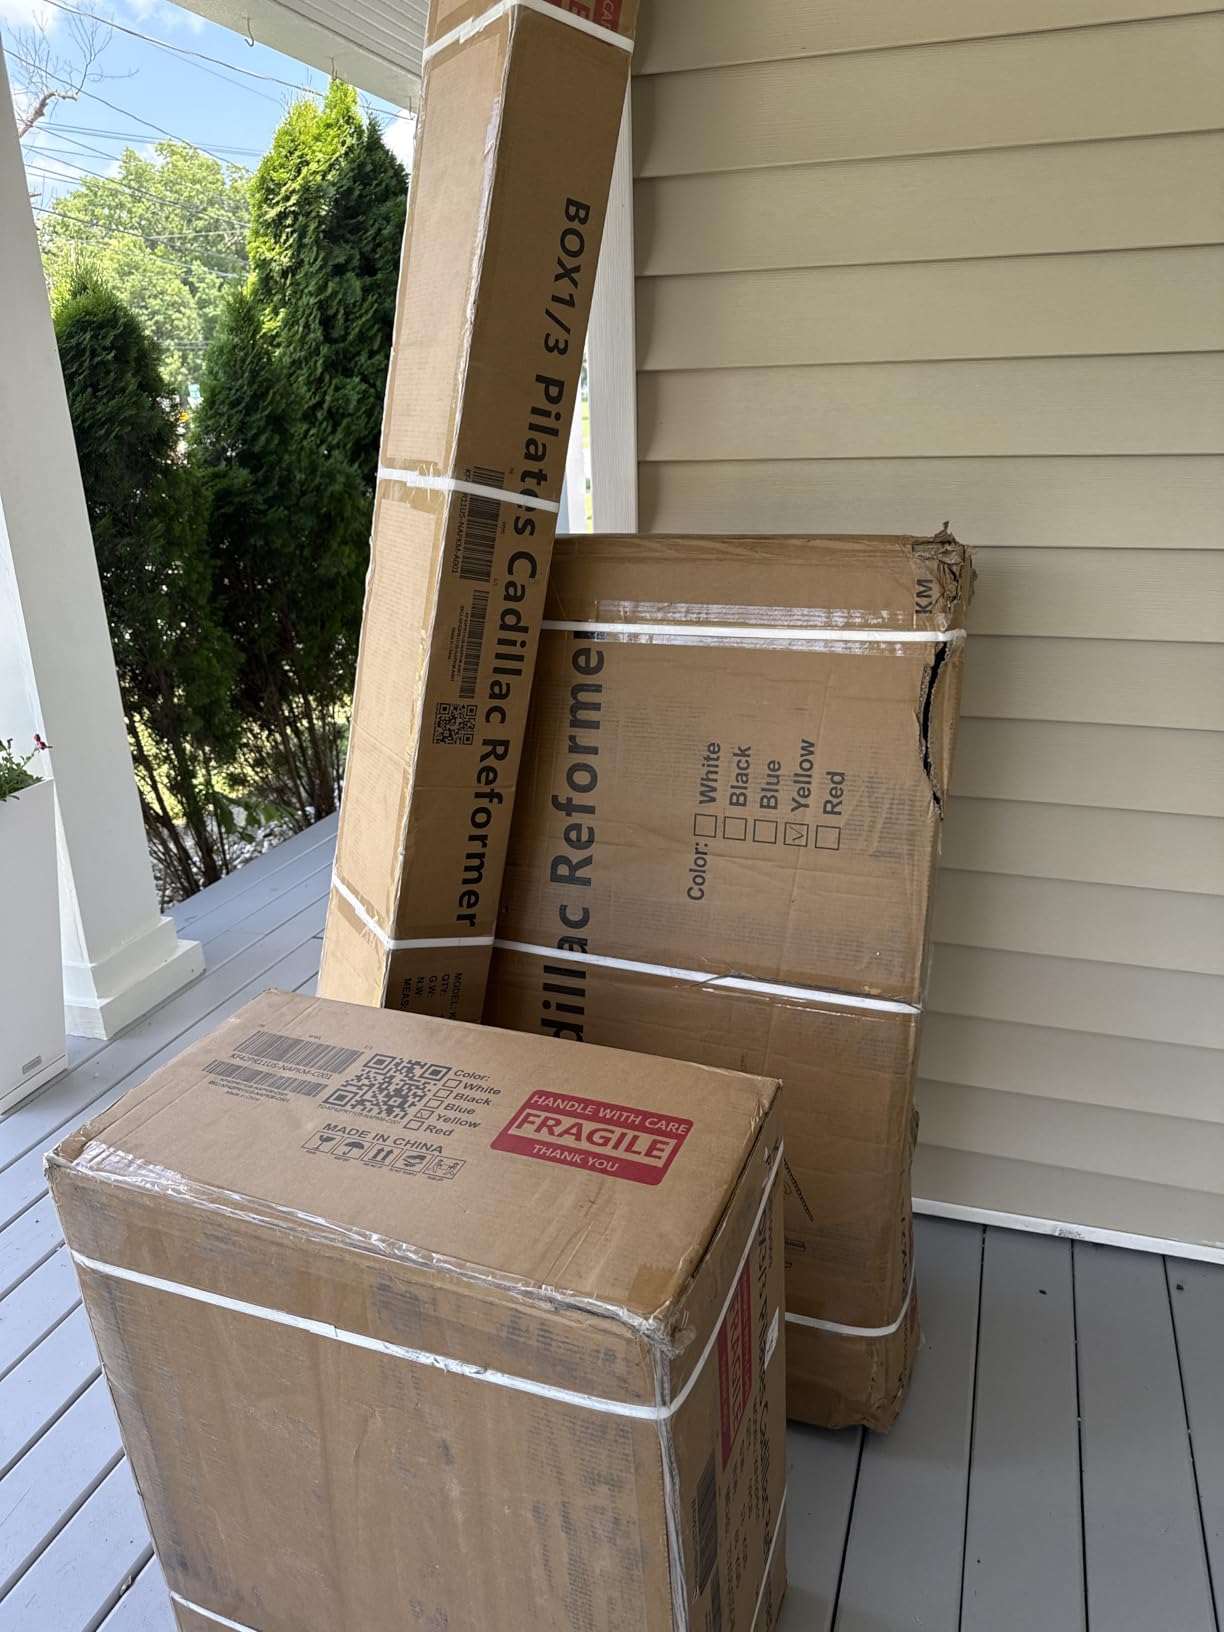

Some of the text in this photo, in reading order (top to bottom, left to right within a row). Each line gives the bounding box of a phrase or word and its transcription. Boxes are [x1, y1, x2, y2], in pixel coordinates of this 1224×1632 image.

[544, 197, 591, 356] BOX1/3
[915, 579, 933, 614] KM
[484, 551, 538, 724] Cadillac
[698, 741, 721, 805] White
[728, 745, 752, 808] Black
[759, 759, 782, 810] Blue
[790, 738, 816, 813] Yellow
[822, 771, 846, 816] Red
[455, 738, 511, 928] Reformer
[686, 842, 709, 901] Color:
[454, 1069, 491, 1082] Color:
[462, 1082, 502, 1096] White
[443, 1102, 476, 1115] Blue
[453, 1092, 492, 1106] Black
[530, 1094, 690, 1135] HANDLE WITH CARE
[321, 1123, 444, 1154] MADE IN CHINA
[423, 1124, 455, 1137] Red
[436, 1113, 481, 1129] Yellow
[514, 1111, 671, 1160] FRAGILE
[532, 1144, 620, 1172] THANK YOU
